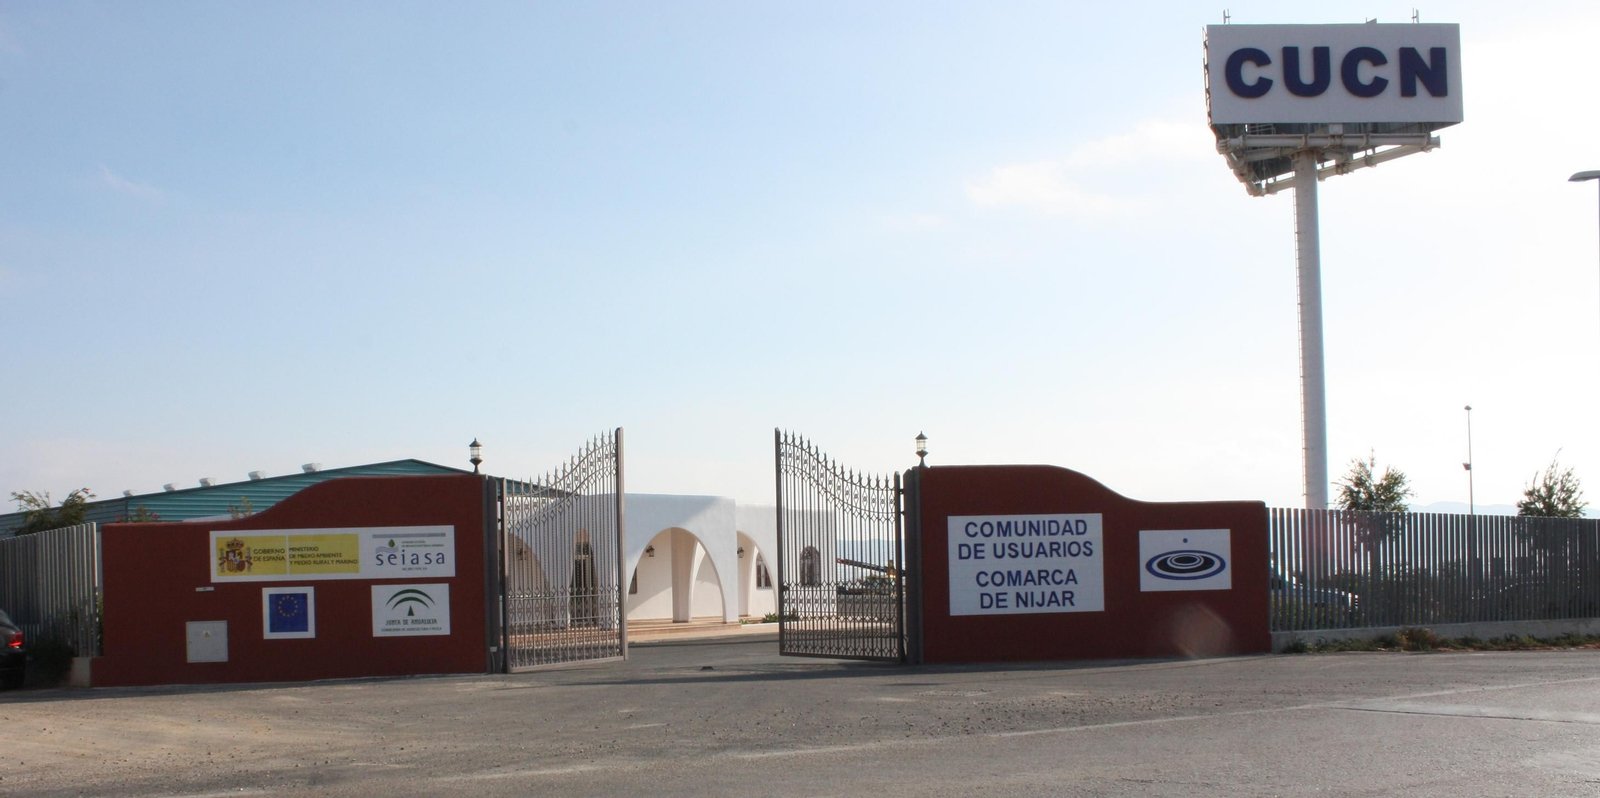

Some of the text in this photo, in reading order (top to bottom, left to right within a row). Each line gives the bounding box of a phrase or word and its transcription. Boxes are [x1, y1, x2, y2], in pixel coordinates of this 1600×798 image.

[1225, 46, 1448, 98] CUCN
[965, 519, 1087, 537] COMUNIDAD
[263, 554, 285, 562] ESPAÑA
[375, 549, 445, 566] seiasa
[958, 541, 1093, 560] DE USUARIOS
[976, 569, 1078, 587] COMARCA
[980, 590, 1075, 609] DE NIJAR
